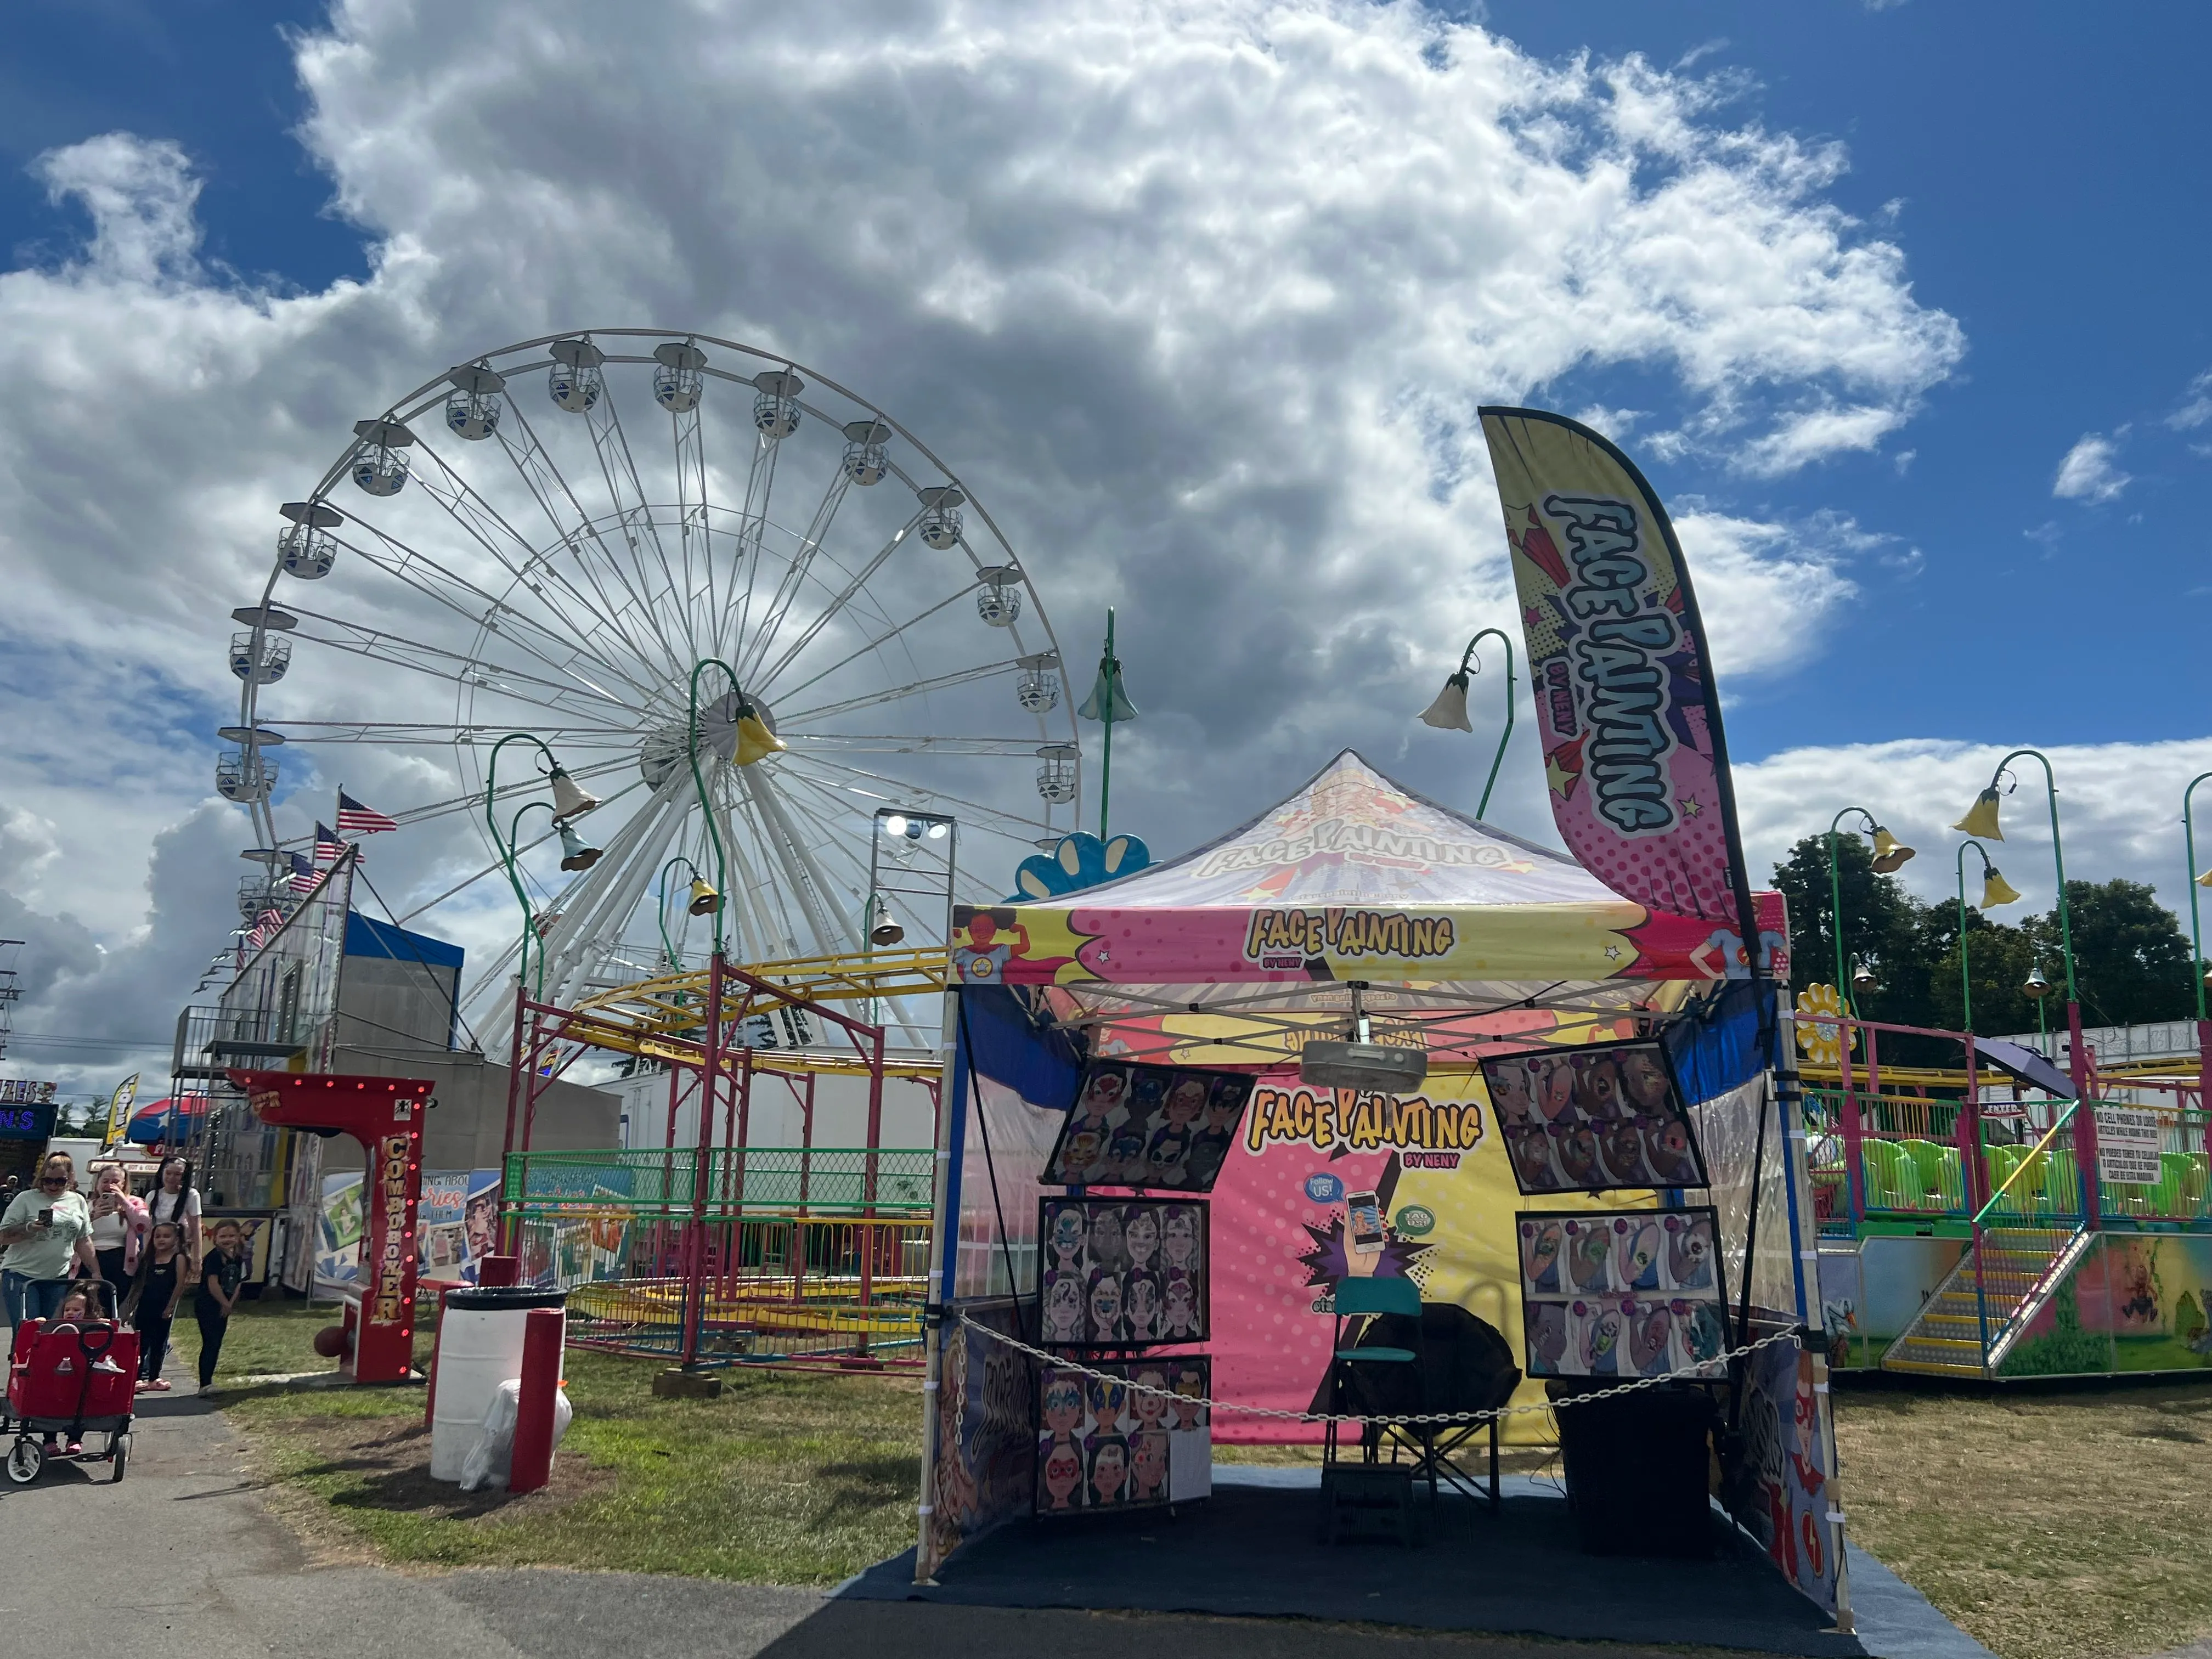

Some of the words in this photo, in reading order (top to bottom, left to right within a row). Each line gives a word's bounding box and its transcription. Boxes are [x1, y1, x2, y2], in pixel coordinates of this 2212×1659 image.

[1544, 495, 1647, 619] FACE
[1546, 661, 1570, 689] BY
[1550, 686, 1577, 737] NENY
[1576, 613, 1675, 832] PAINTING
[1197, 837, 1311, 877] FACE
[1313, 819, 1508, 866] PAINTING
[1247, 909, 1324, 958] FACE
[1325, 907, 1454, 957] PAINTING
[1262, 957, 1277, 968] BY
[1277, 957, 1302, 968] NENY
[0, 1080, 37, 1102] ZES
[1248, 1088, 1335, 1151] FACE
[1335, 1087, 1483, 1150] PAINTING
[1988, 1104, 2018, 1114] ENTER
[2104, 1112, 2116, 1124] CELL
[1403, 1153, 1423, 1169] BY
[1424, 1153, 1461, 1169] NENY
[1310, 1177, 1334, 1186] Follow
[1313, 1183, 1333, 1197] US!
